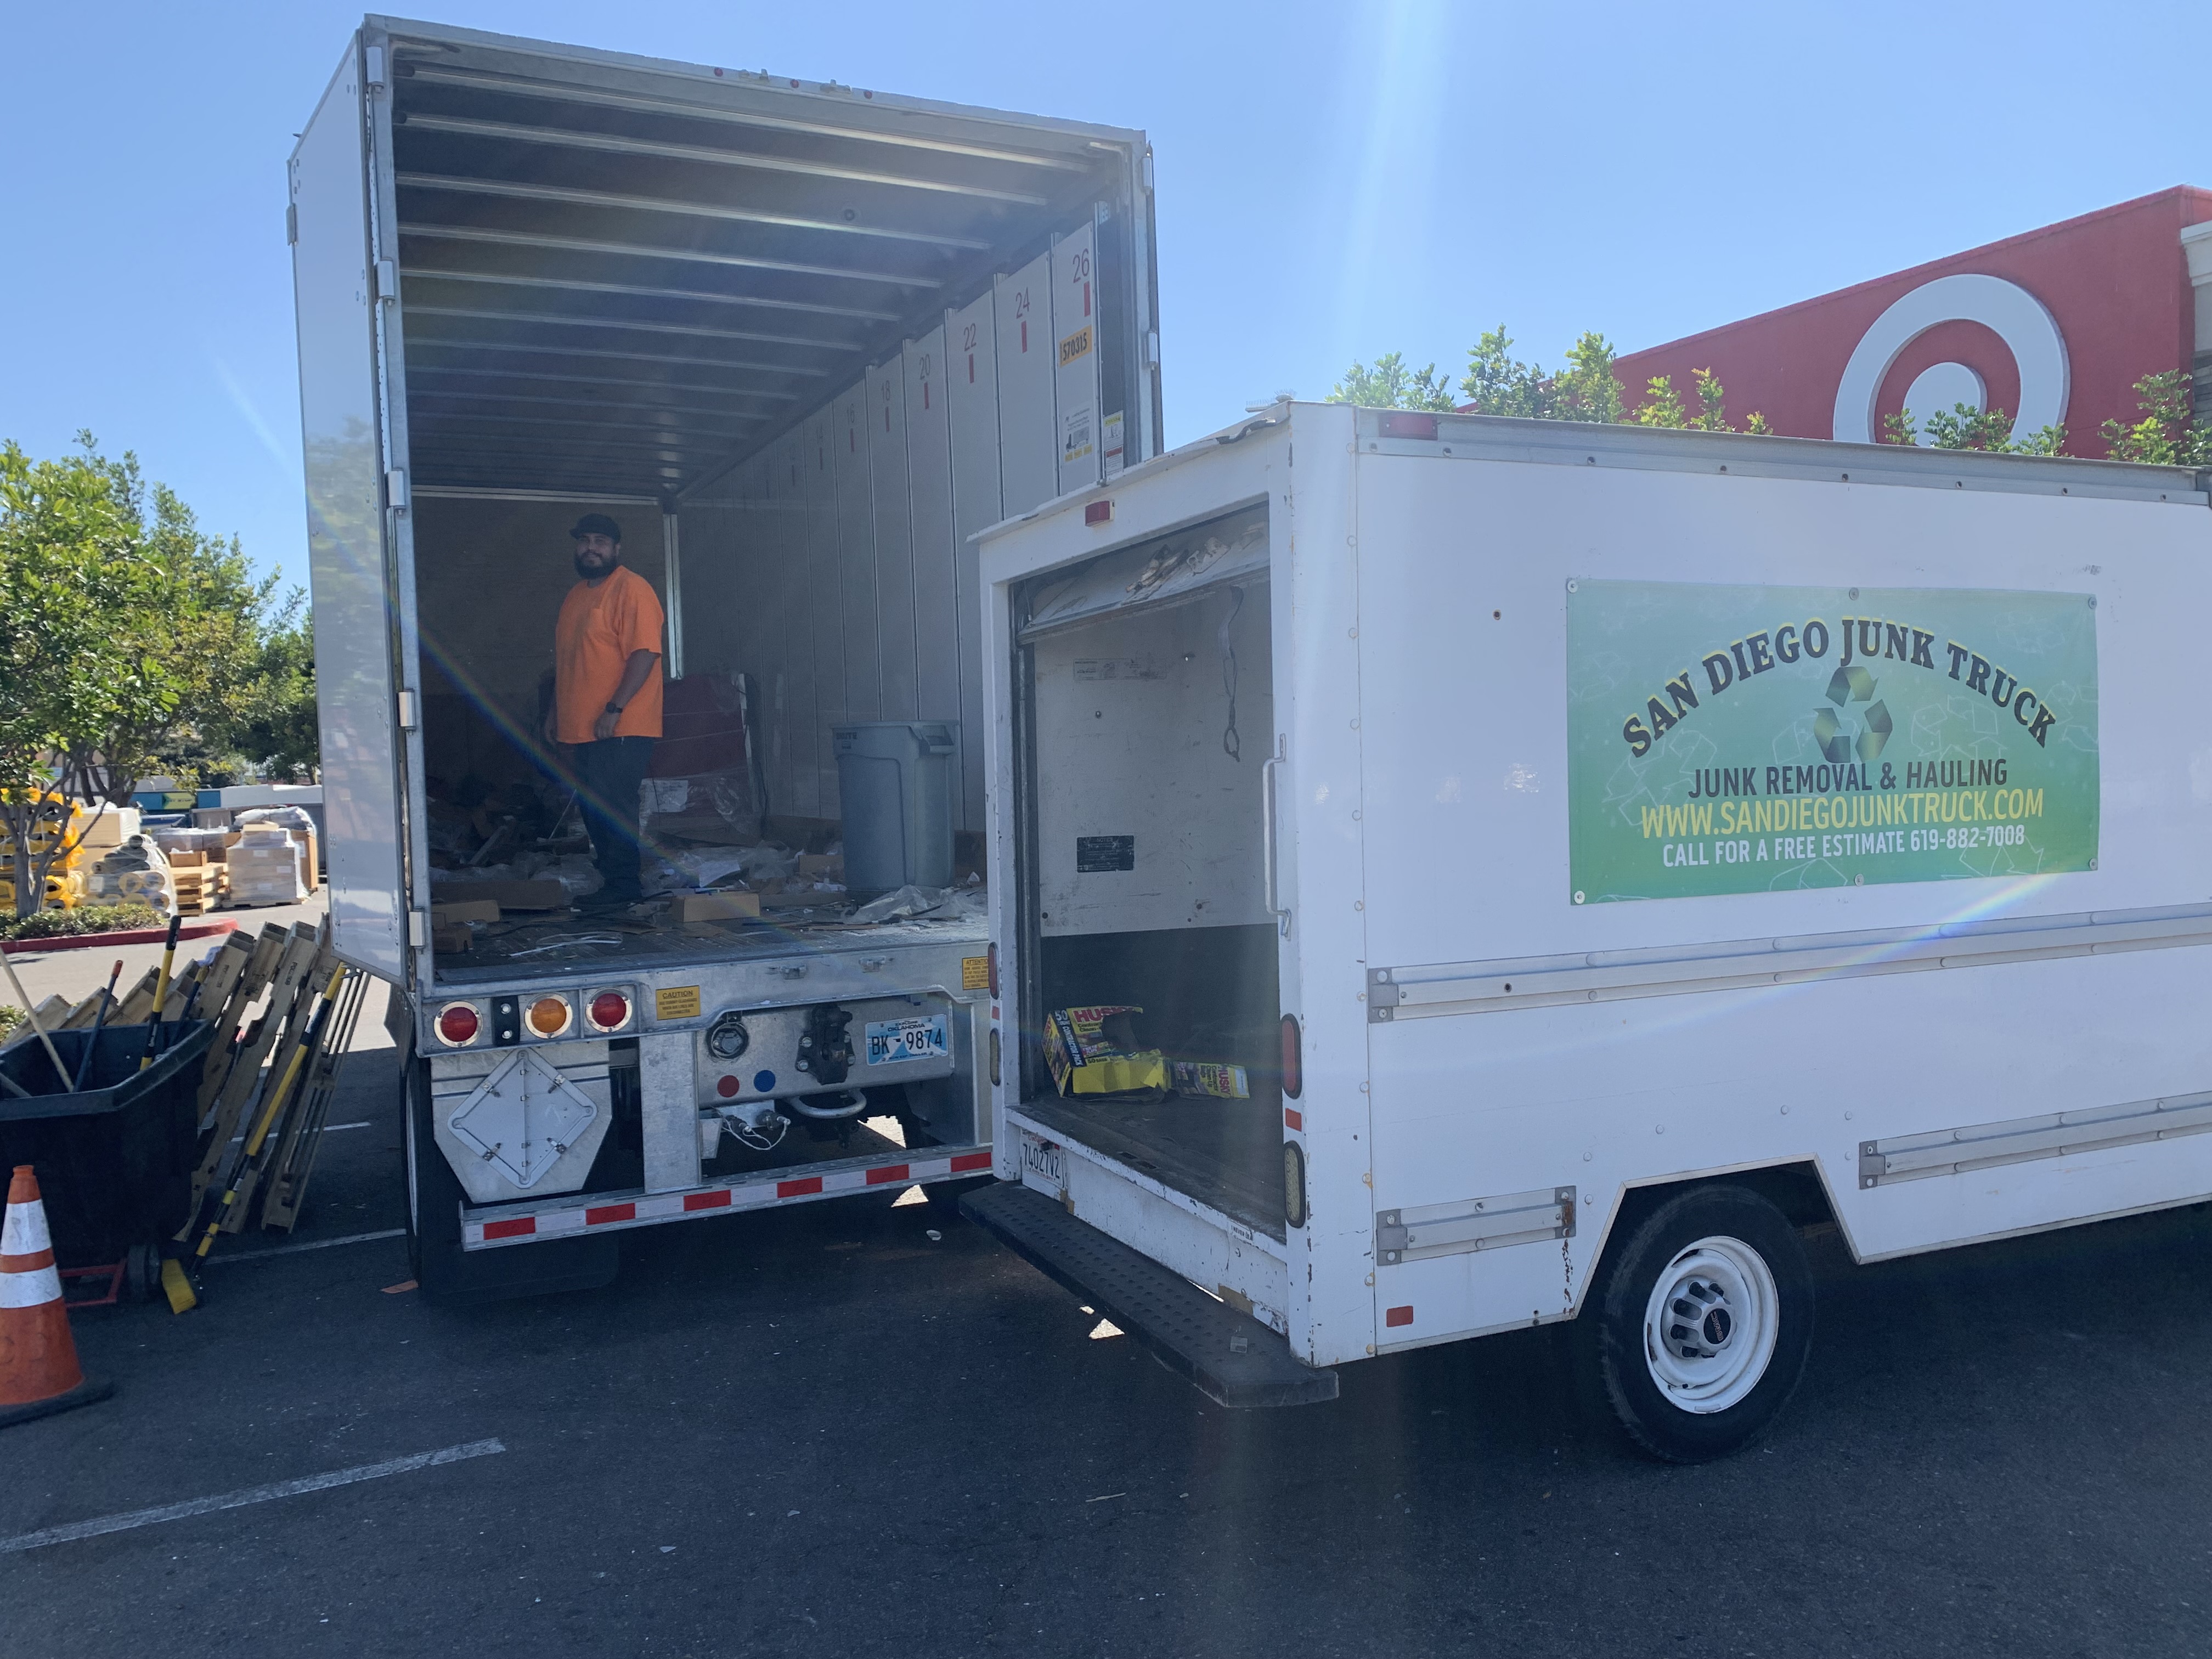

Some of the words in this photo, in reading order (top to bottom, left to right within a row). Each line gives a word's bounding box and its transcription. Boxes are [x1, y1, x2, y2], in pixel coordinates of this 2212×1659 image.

[1073, 247, 1090, 284] 26
[1015, 286, 1030, 319] 24
[963, 322, 977, 352] 22
[1063, 331, 1087, 361] 570315
[919, 353, 930, 380] 20
[881, 380, 890, 403] 18
[1623, 670, 1700, 758] SAN
[1701, 617, 1830, 695] DIEGO
[1839, 616, 1936, 669] JUNK
[1946, 639, 2056, 748] TRUCK
[1688, 766, 1757, 798] JUNK
[1765, 763, 1872, 795] REMOVAL
[1880, 761, 1897, 789] &
[1906, 759, 2008, 788] HAULING
[1641, 788, 2044, 839] WWW.SANDIEGOJUNKTRUCK.COM
[1663, 841, 1709, 868] CALL
[1715, 838, 1750, 865] FOR
[1757, 838, 1769, 862] A
[1774, 834, 1816, 861] FREE
[1822, 831, 1905, 858] ESTIMATE
[1910, 825, 2025, 851] 619-882-7008
[663, 990, 693, 999] CAUTION
[888, 1023, 926, 1032] OKLAHOMA
[1054, 1009, 1068, 1022] 50
[1062, 1026, 1077, 1055] CONTRACTOR
[1023, 1143, 1060, 1179] 74027V2
[1709, 1310, 1724, 1341] GMC
